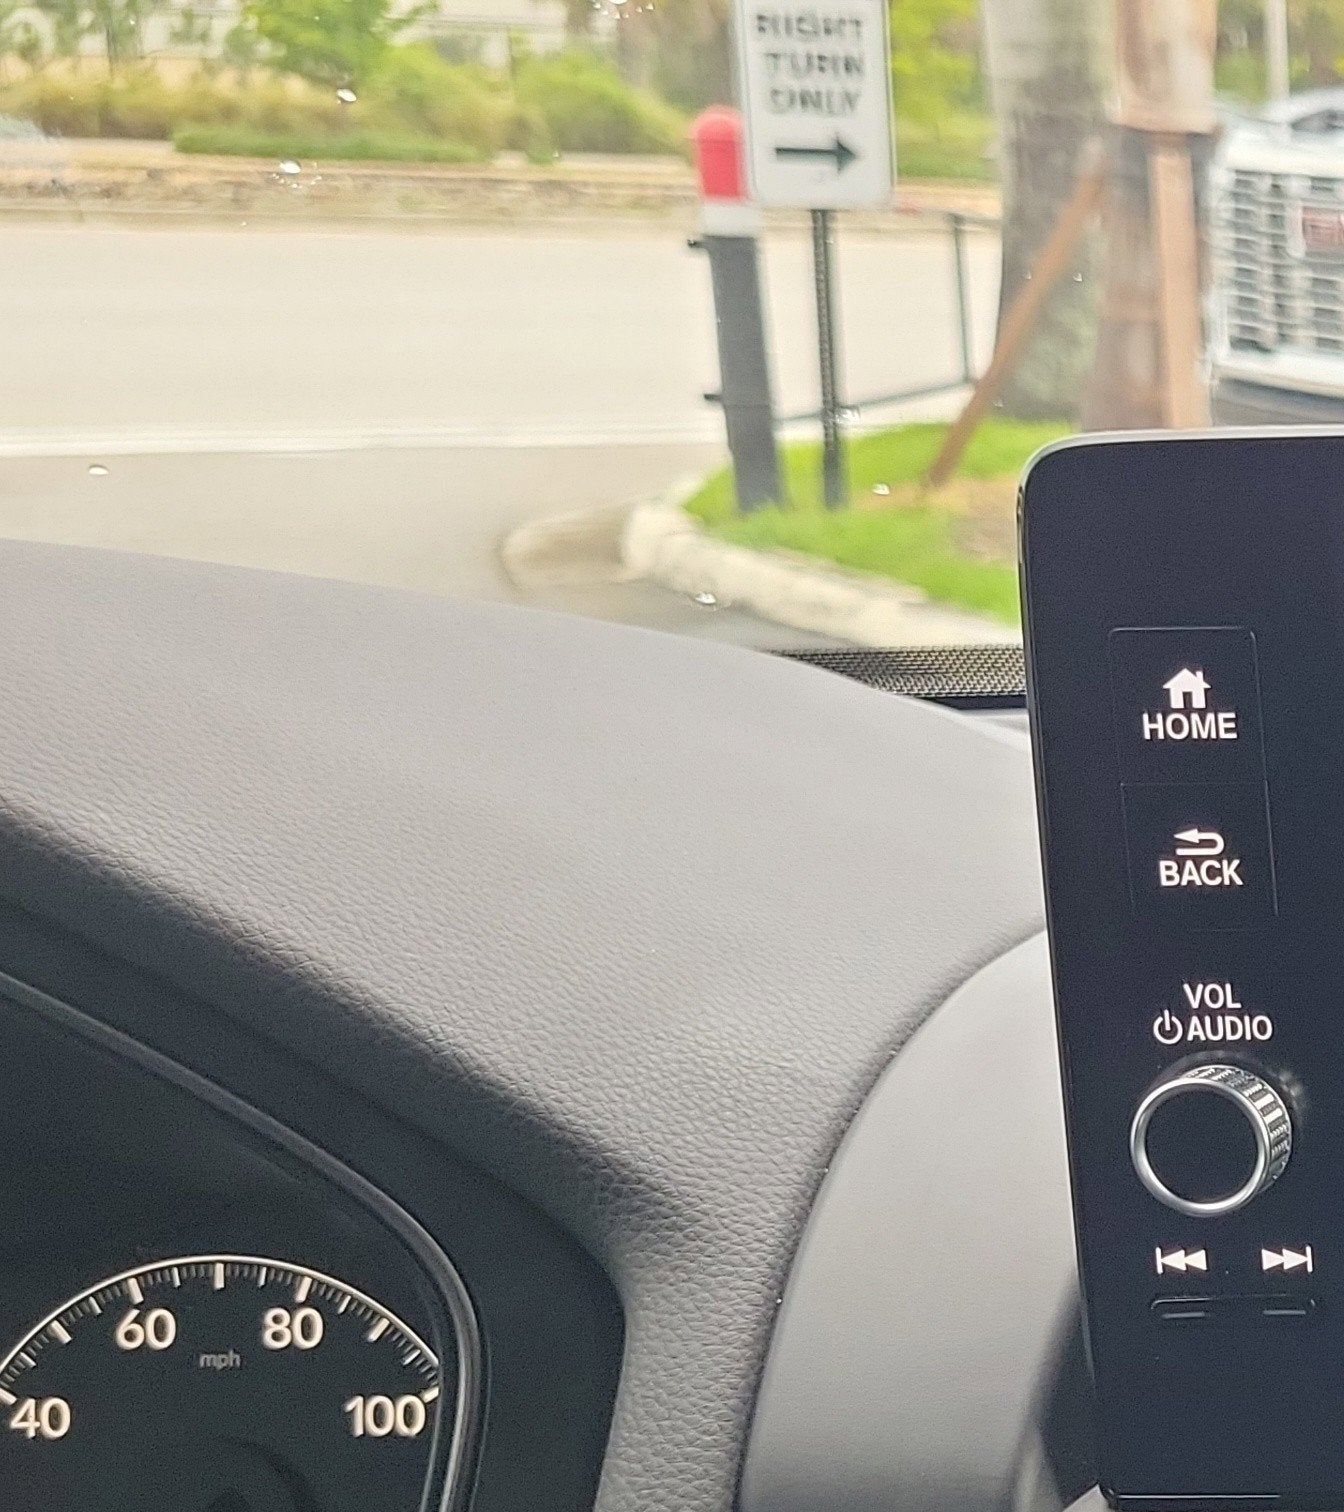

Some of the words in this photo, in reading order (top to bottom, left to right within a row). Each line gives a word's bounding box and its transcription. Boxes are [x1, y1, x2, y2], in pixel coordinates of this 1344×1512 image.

[757, 14, 863, 37] RIGHT
[766, 52, 864, 77] TURN
[769, 88, 860, 116] ONLY
[1142, 712, 1238, 740] HOME
[1159, 859, 1244, 887] BACK
[1182, 982, 1242, 1009] VOL
[1186, 1014, 1273, 1042] AUDIO
[115, 1307, 177, 1351] 60
[262, 1307, 325, 1350] 80
[200, 1352, 241, 1368] mph
[10, 1396, 72, 1439] 40
[344, 1394, 426, 1438] 100
